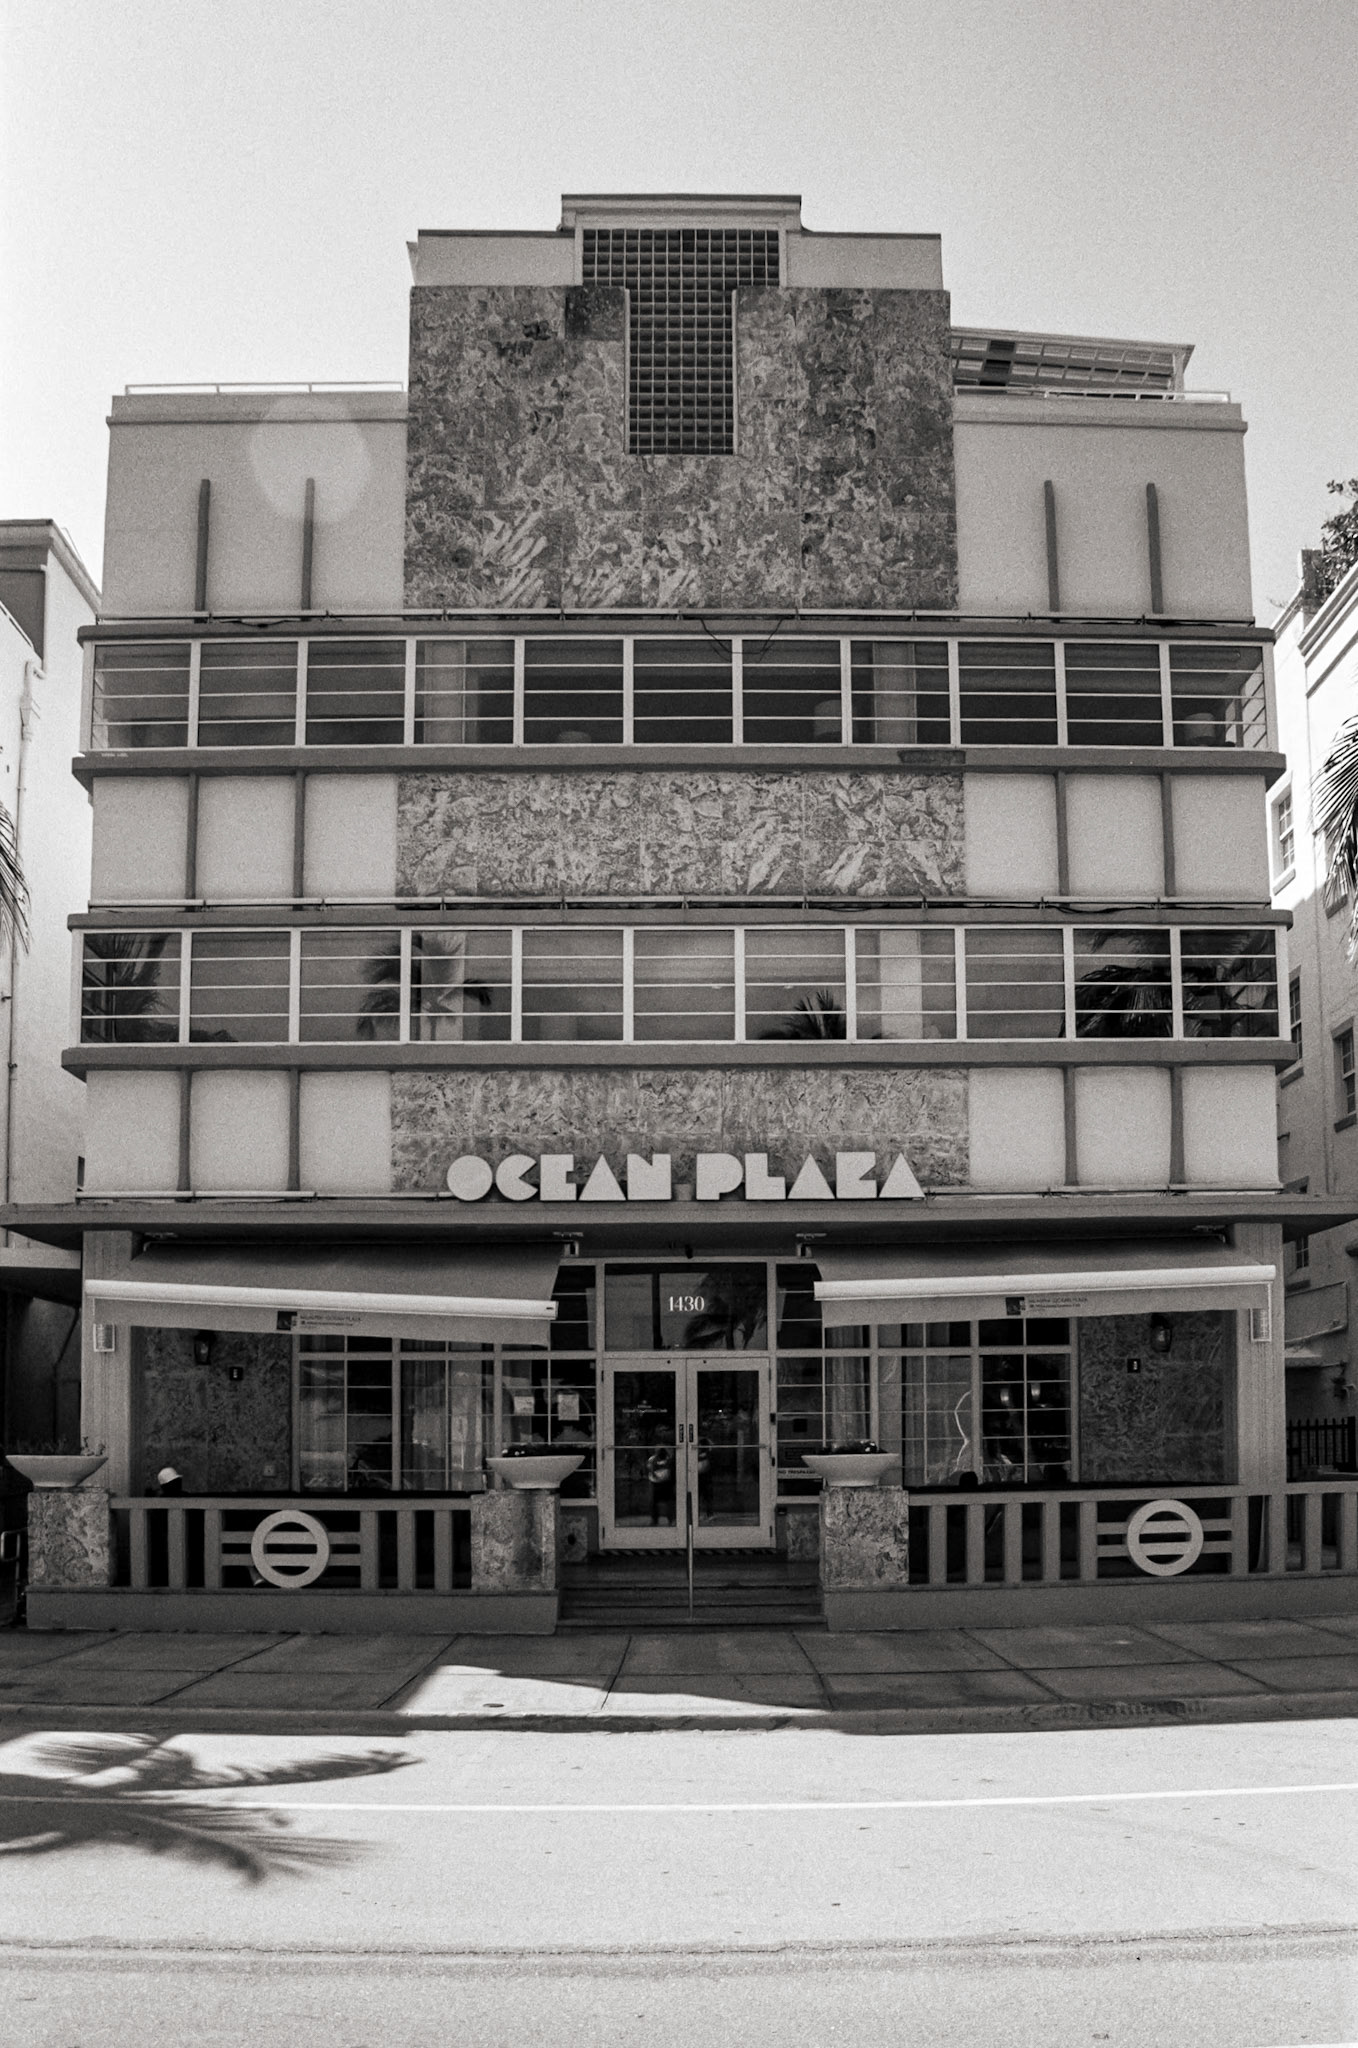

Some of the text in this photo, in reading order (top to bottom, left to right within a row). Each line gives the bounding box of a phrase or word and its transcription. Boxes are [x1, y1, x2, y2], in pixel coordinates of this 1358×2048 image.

[446, 1151, 926, 1201] OCEAN PLAZA
[669, 1295, 705, 1311] 1430
